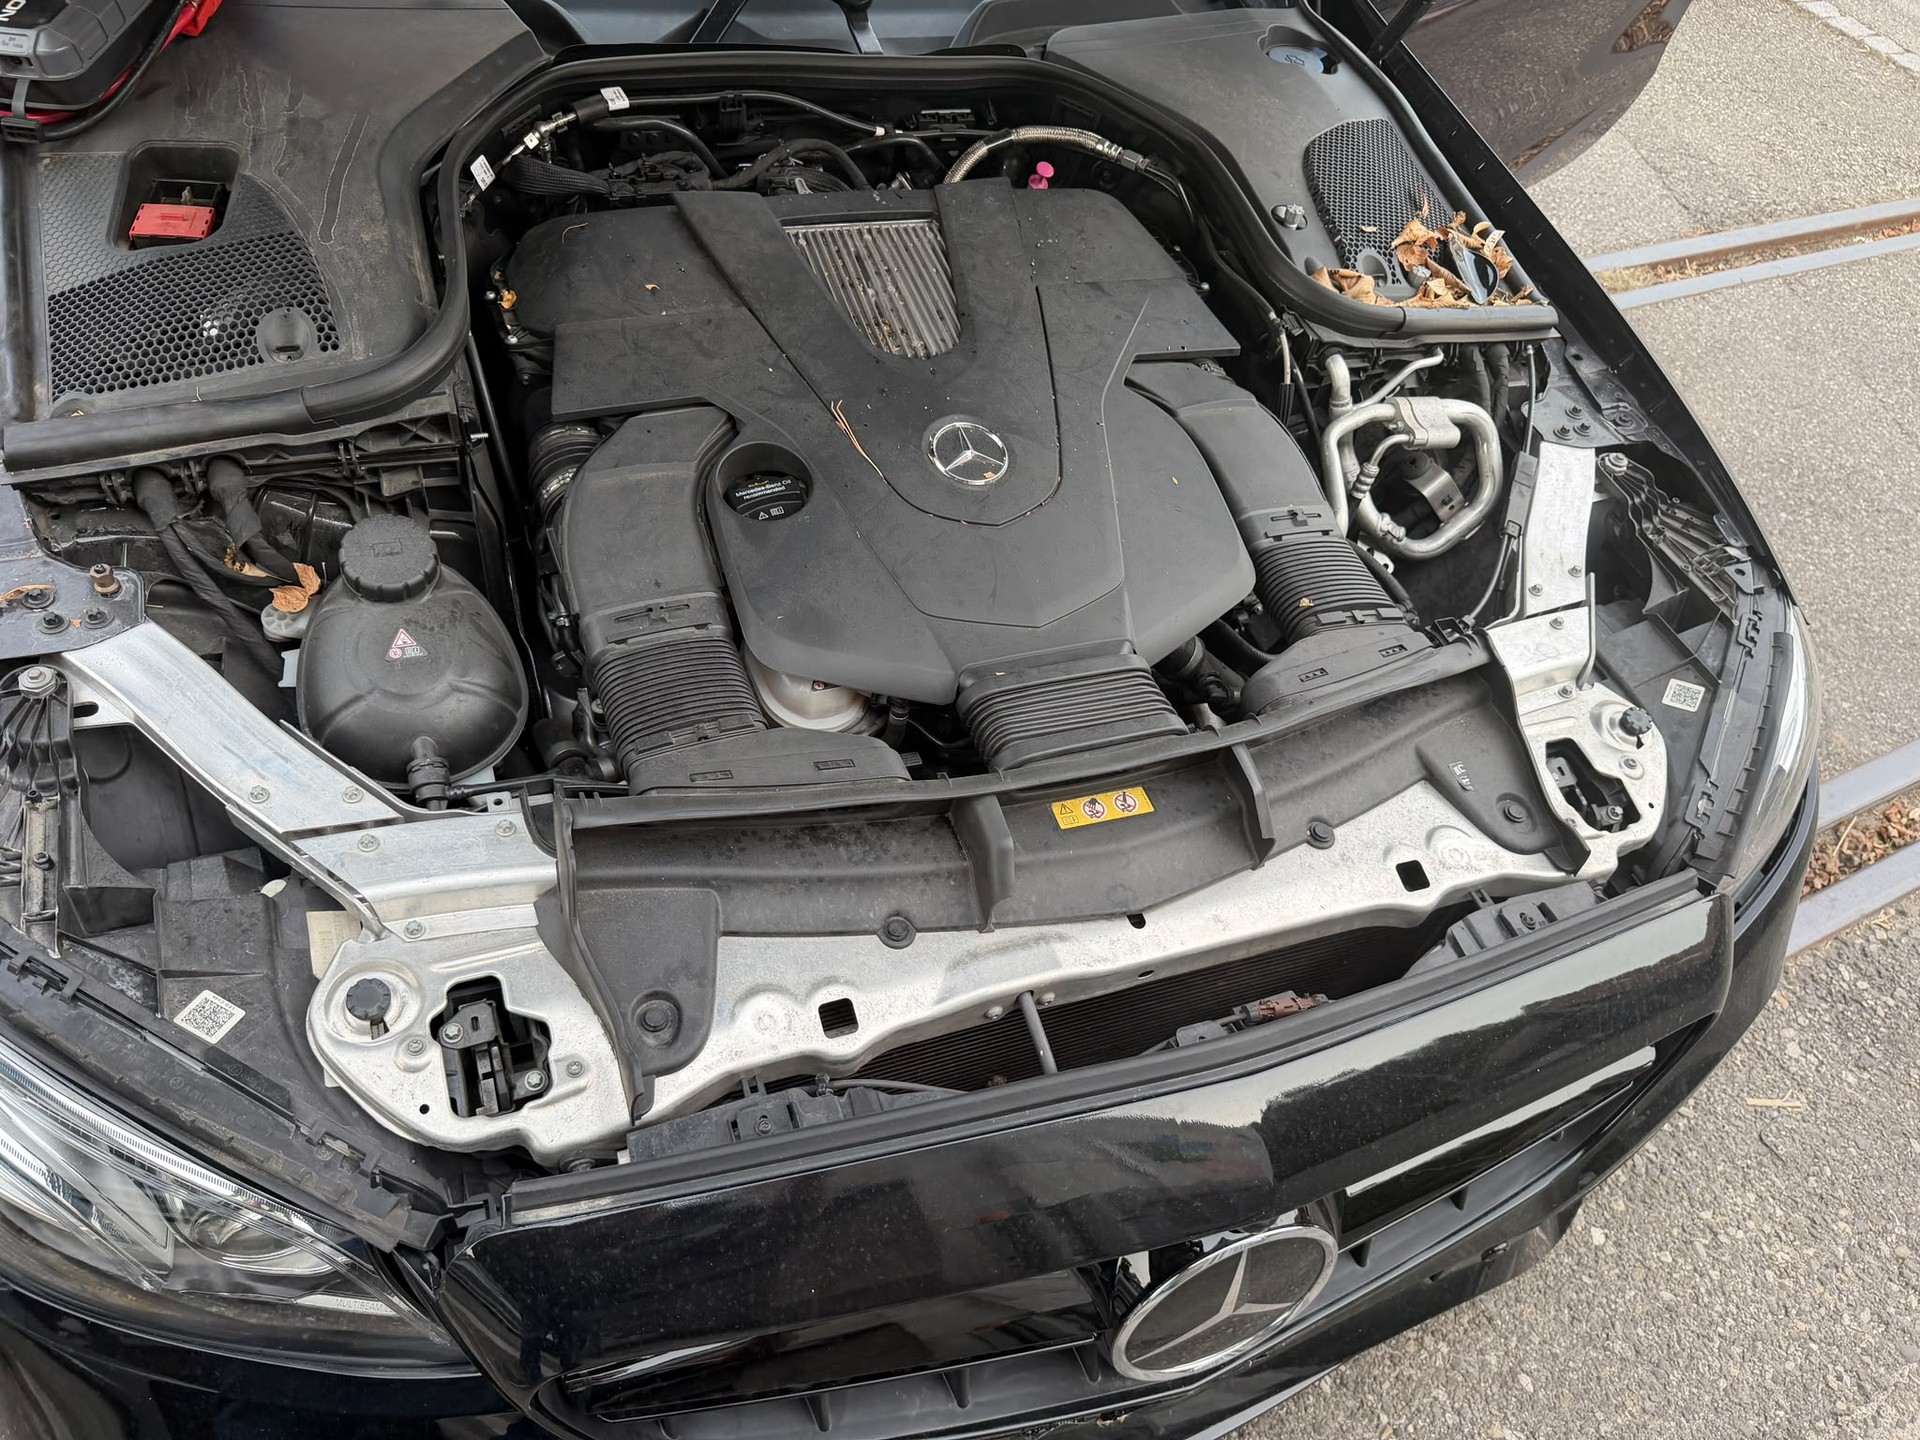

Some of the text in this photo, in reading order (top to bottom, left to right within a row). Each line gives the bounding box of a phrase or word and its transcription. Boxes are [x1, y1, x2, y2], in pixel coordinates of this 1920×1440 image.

[735, 482, 781, 497] Mercedes-Benz
[743, 485, 786, 500] recommended
[335, 1298, 383, 1312] MULTIBEAM
